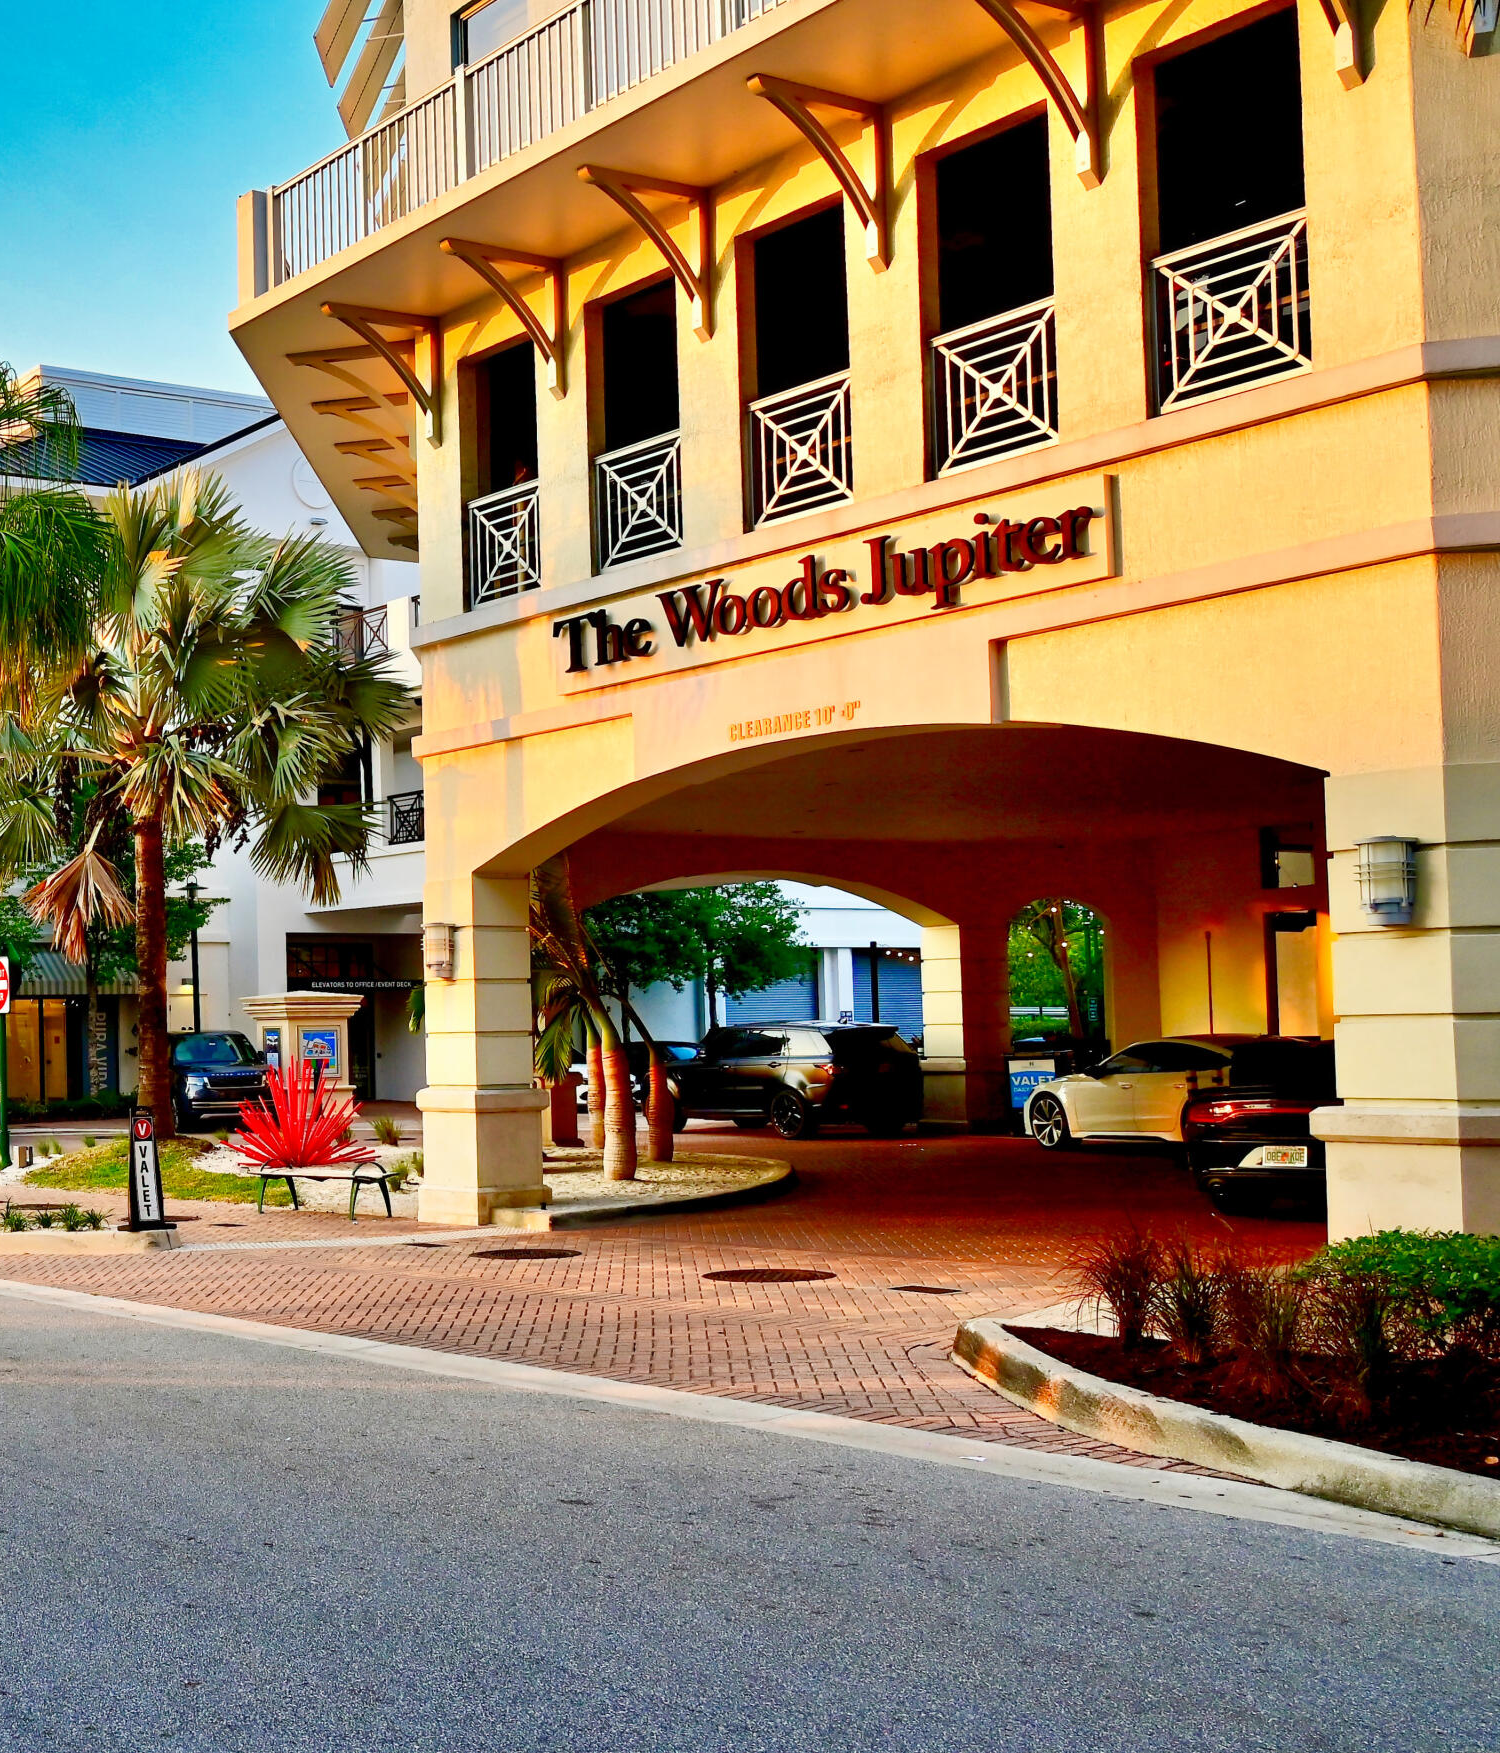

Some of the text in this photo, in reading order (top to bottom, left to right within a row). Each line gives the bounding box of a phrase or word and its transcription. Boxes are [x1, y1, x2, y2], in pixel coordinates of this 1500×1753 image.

[553, 506, 1094, 673] The Woods Jupiter
[729, 710, 811, 742] CLEARANCE
[1011, 1075, 1054, 1085] VALET
[138, 1123, 147, 1136] V
[139, 1145, 152, 1217] VALET
